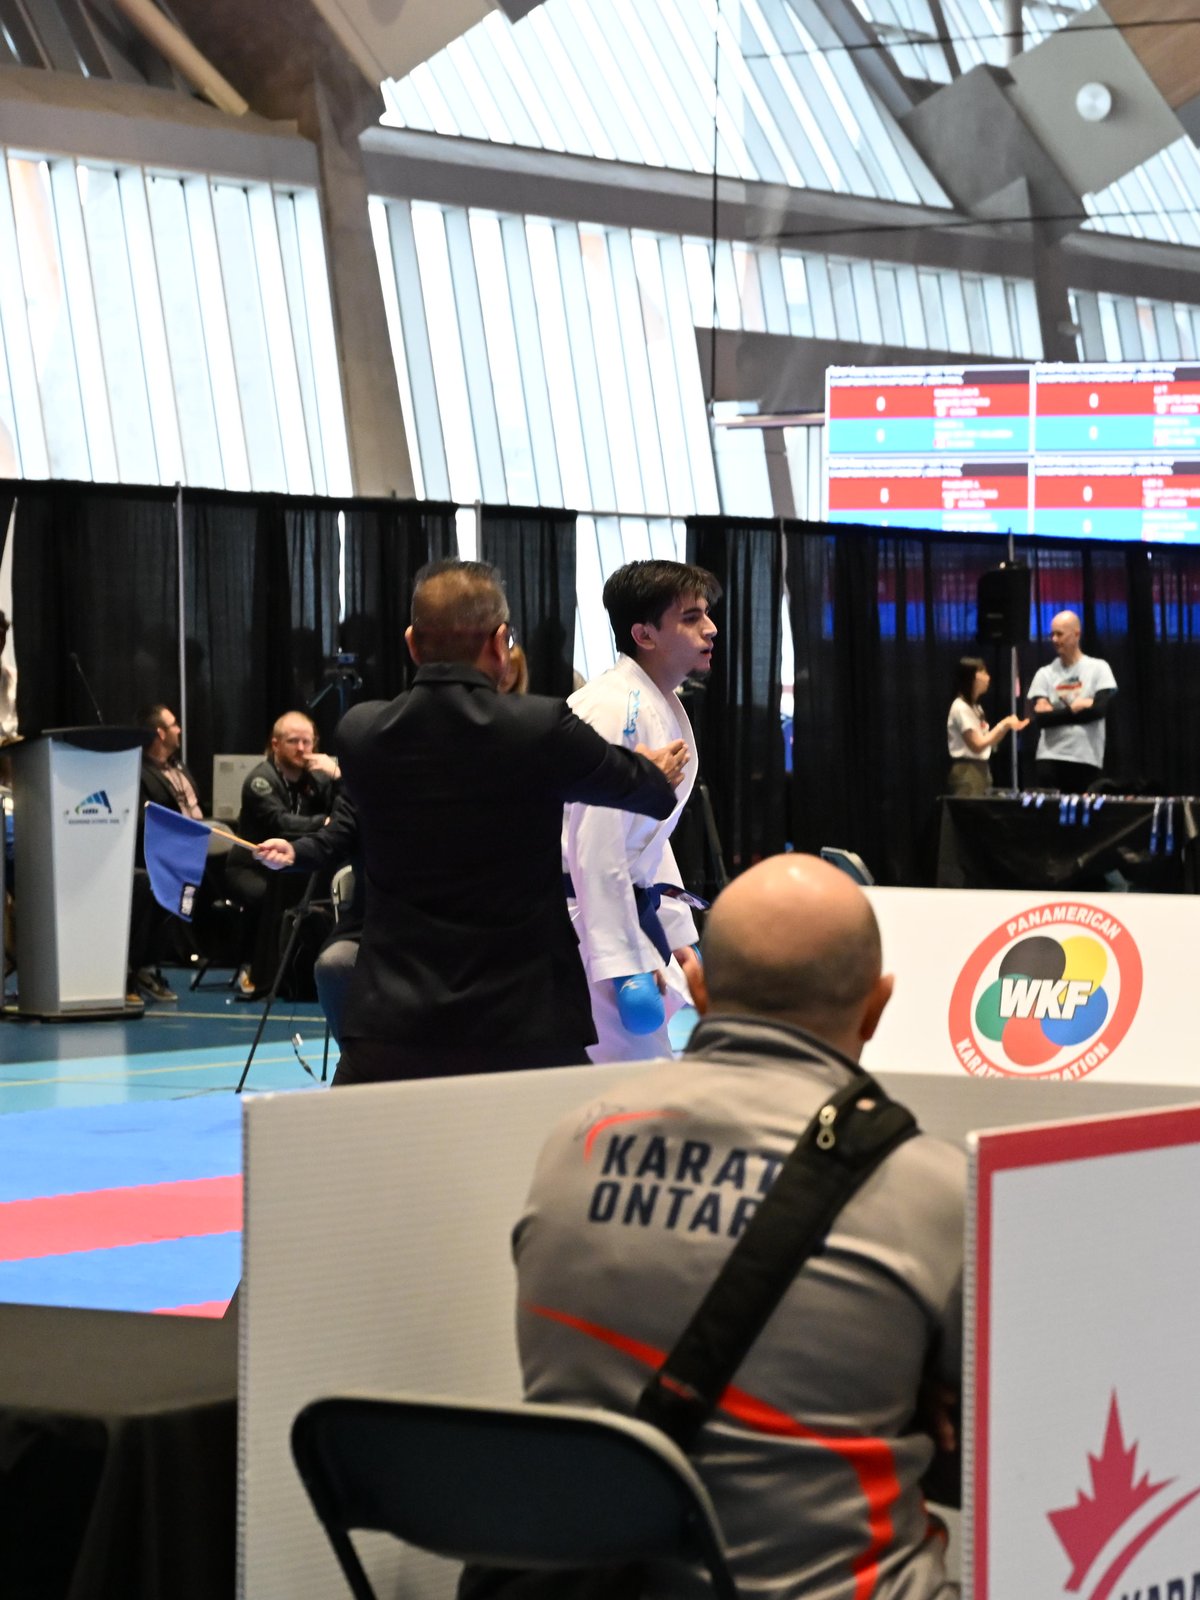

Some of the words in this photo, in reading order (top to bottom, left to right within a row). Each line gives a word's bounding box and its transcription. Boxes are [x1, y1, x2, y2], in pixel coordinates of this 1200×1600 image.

[1006, 905, 1121, 941] PANAMERICAN
[1000, 978, 1093, 1020] WKF
[1007, 1042, 1110, 1081] RATION
[601, 1134, 786, 1194] KARAT
[588, 1180, 764, 1238] ONTAR
